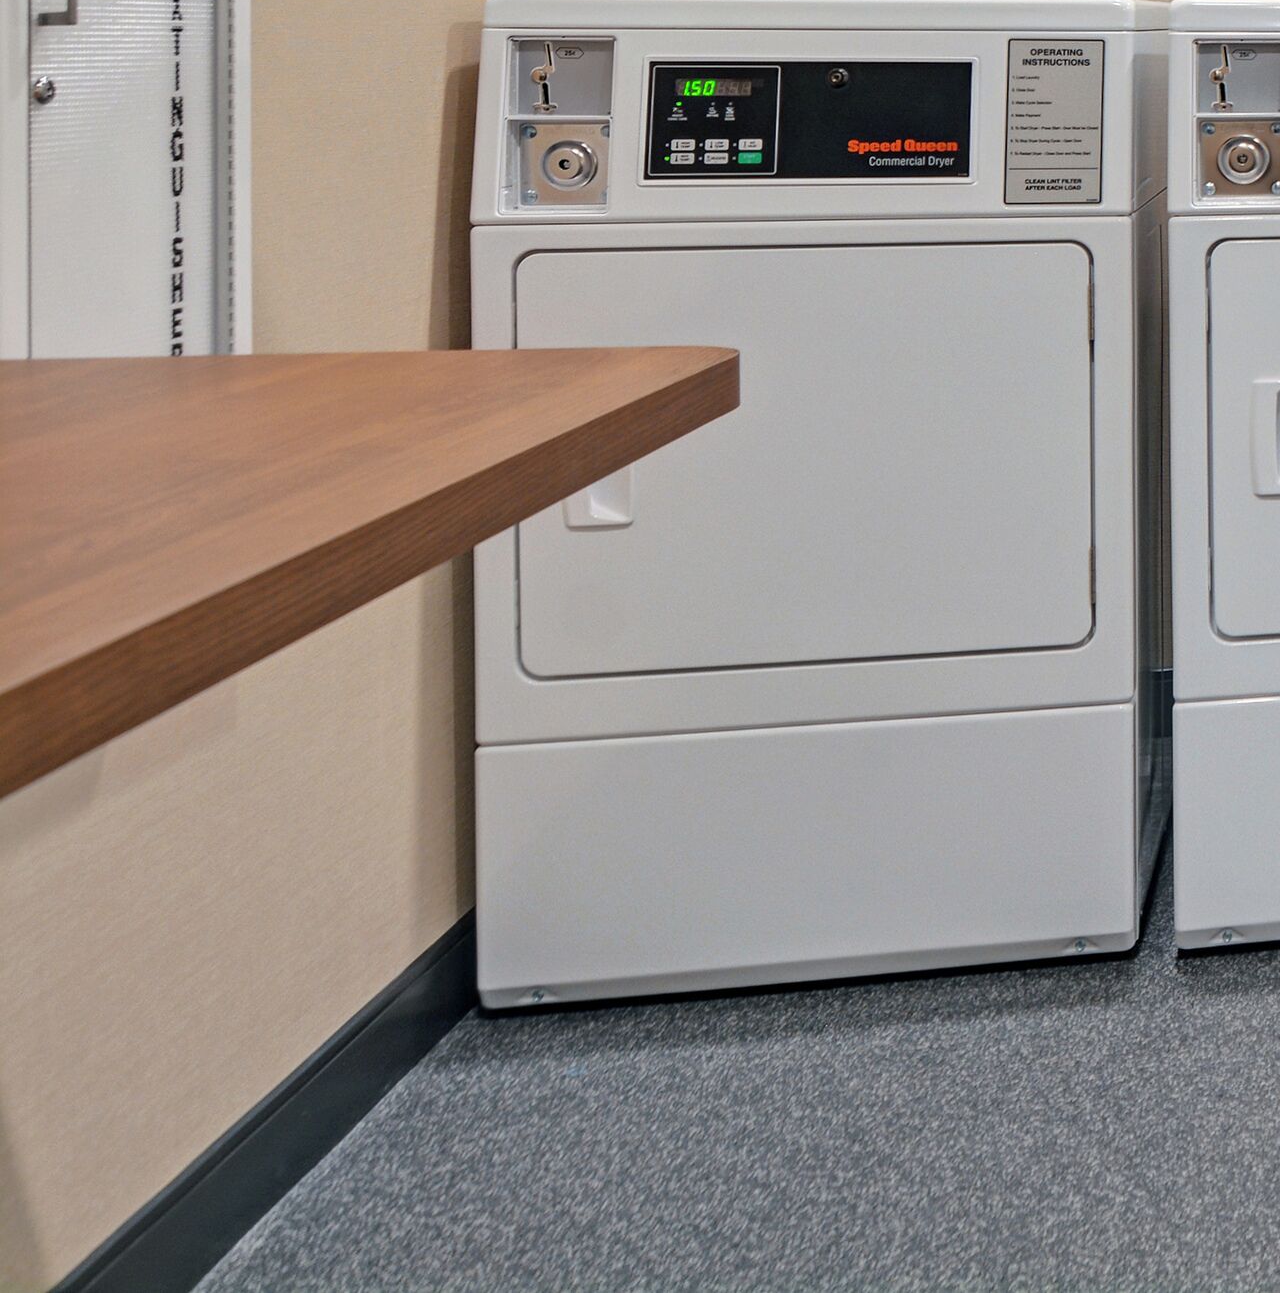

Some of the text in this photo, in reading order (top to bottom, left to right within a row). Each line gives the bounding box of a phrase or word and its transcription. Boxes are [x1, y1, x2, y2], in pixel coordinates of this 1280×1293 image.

[1030, 48, 1083, 56] OPERATING
[1022, 58, 1091, 66] INSTRUCTIONS
[683, 80, 716, 96] 1.50
[847, 139, 958, 154] Speed Queen
[869, 156, 955, 168] Commercial Dryer
